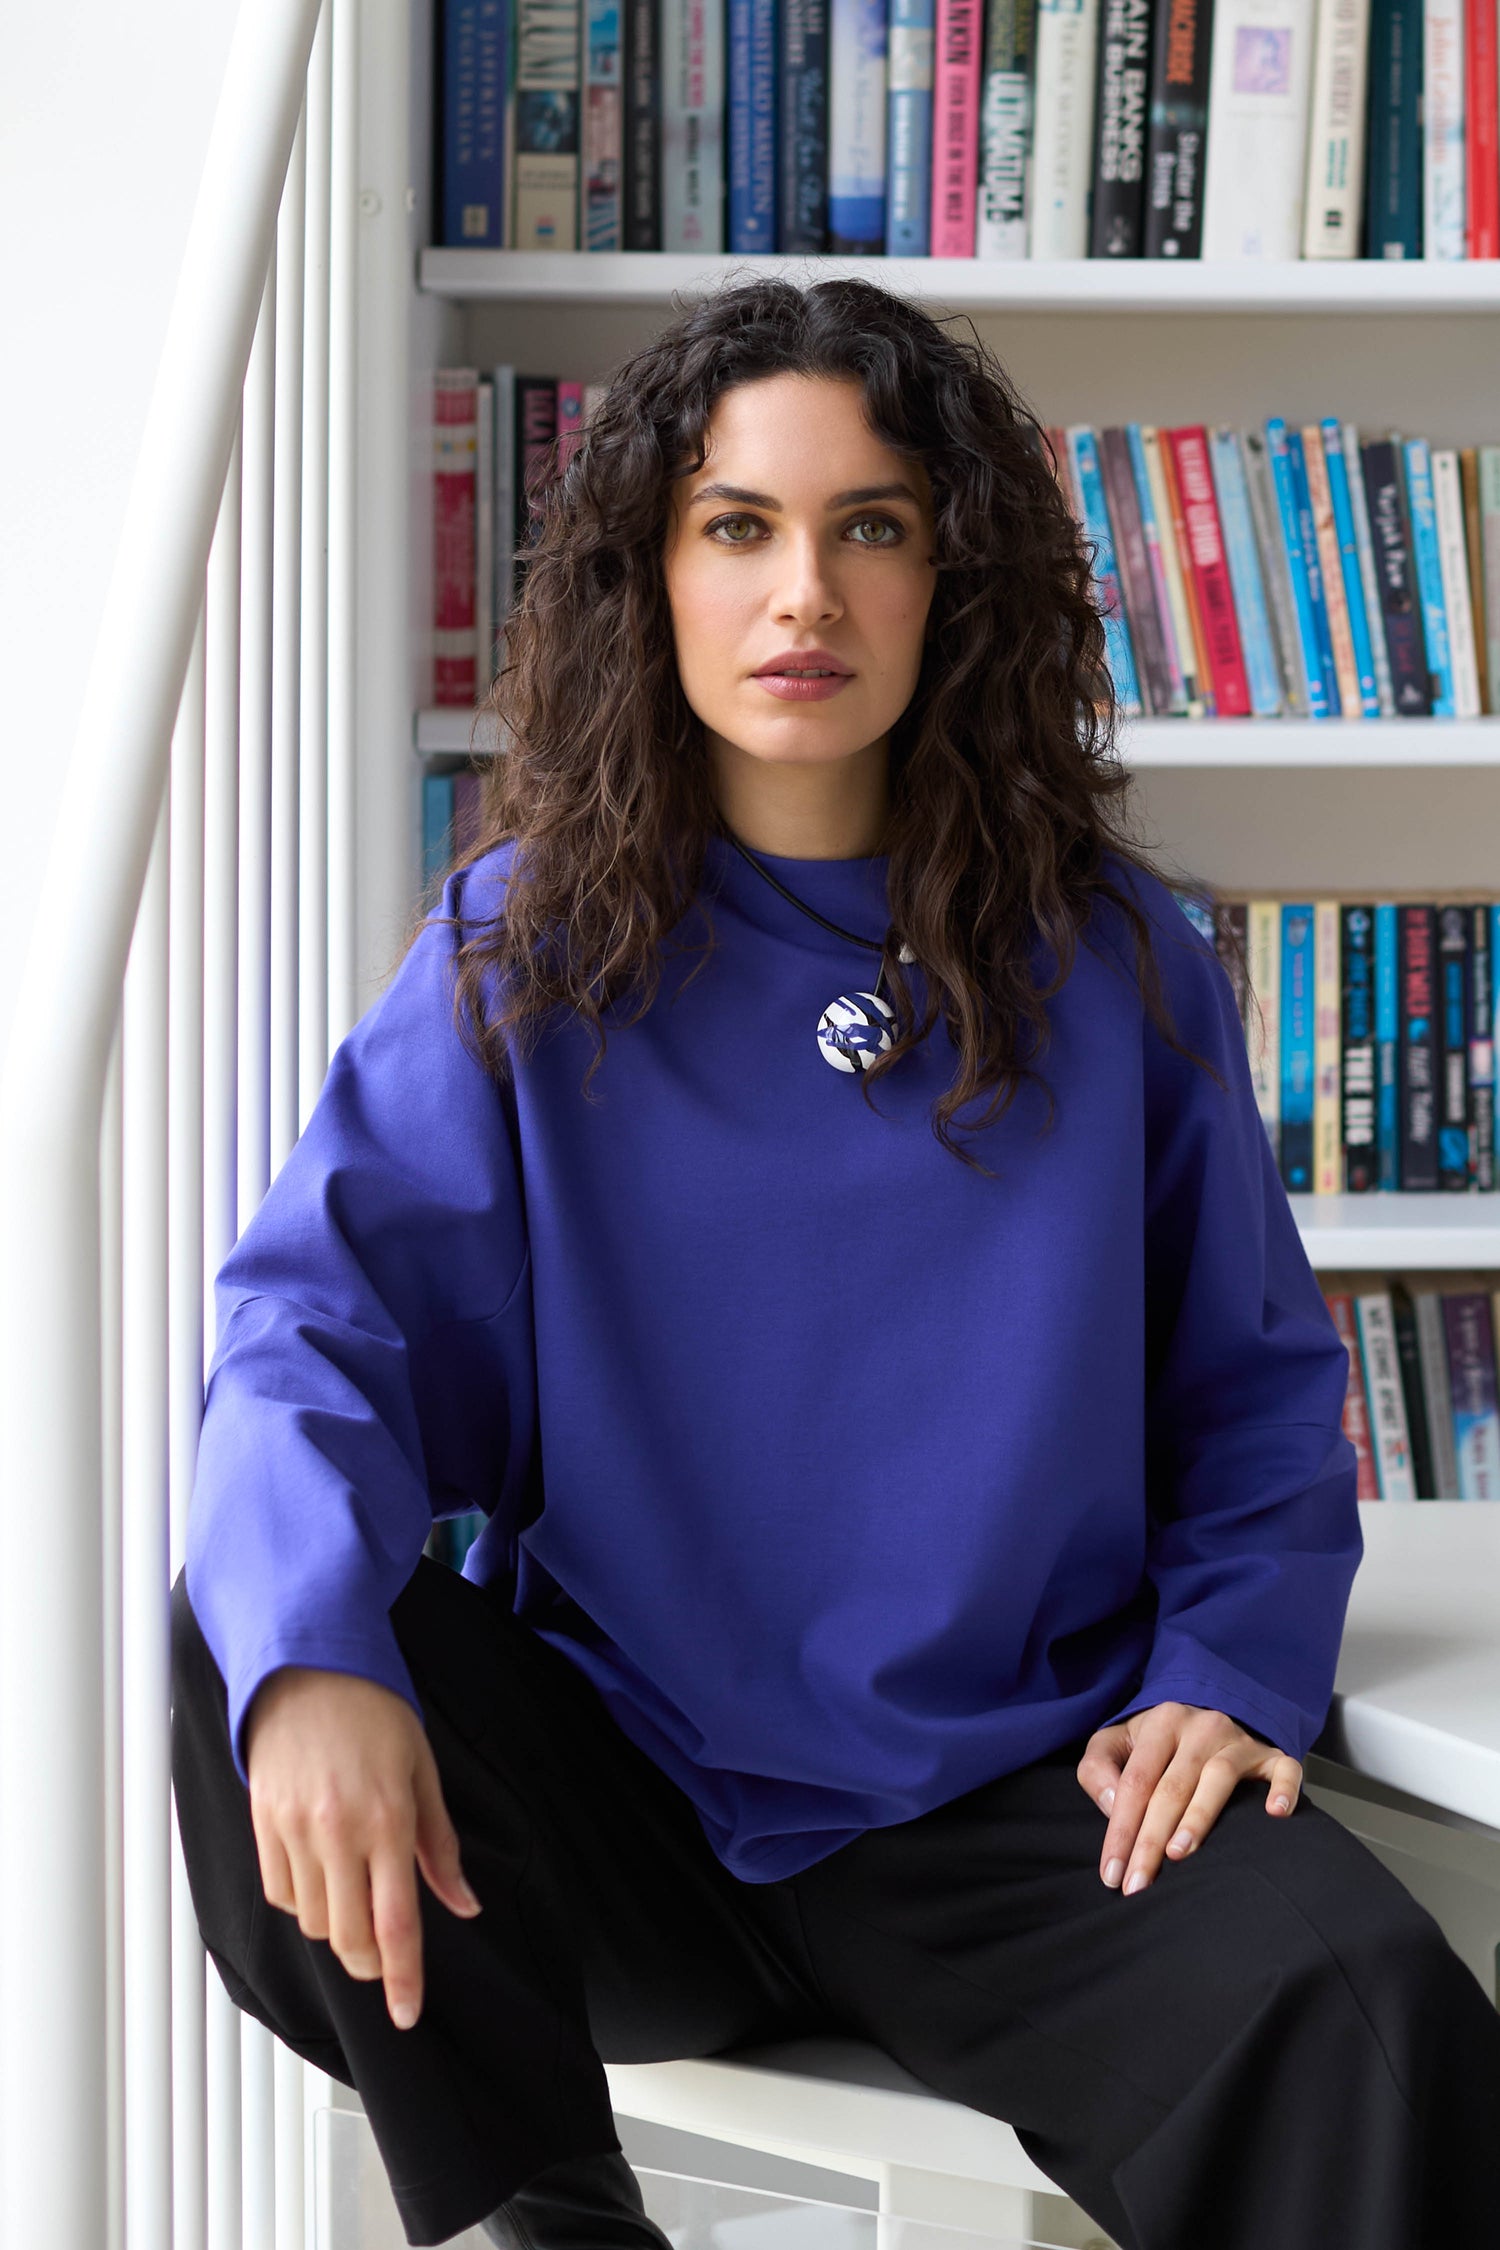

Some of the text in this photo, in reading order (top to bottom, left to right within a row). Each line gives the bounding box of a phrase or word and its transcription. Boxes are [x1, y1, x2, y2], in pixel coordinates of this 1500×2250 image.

[946, 0, 972, 66] NKIN
[1101, 43, 1124, 182] BUSINESS
[1119, 0, 1149, 182] AIN BANKS
[1174, 200, 1195, 231] the
[1344, 1046, 1373, 1145] THE RIG
